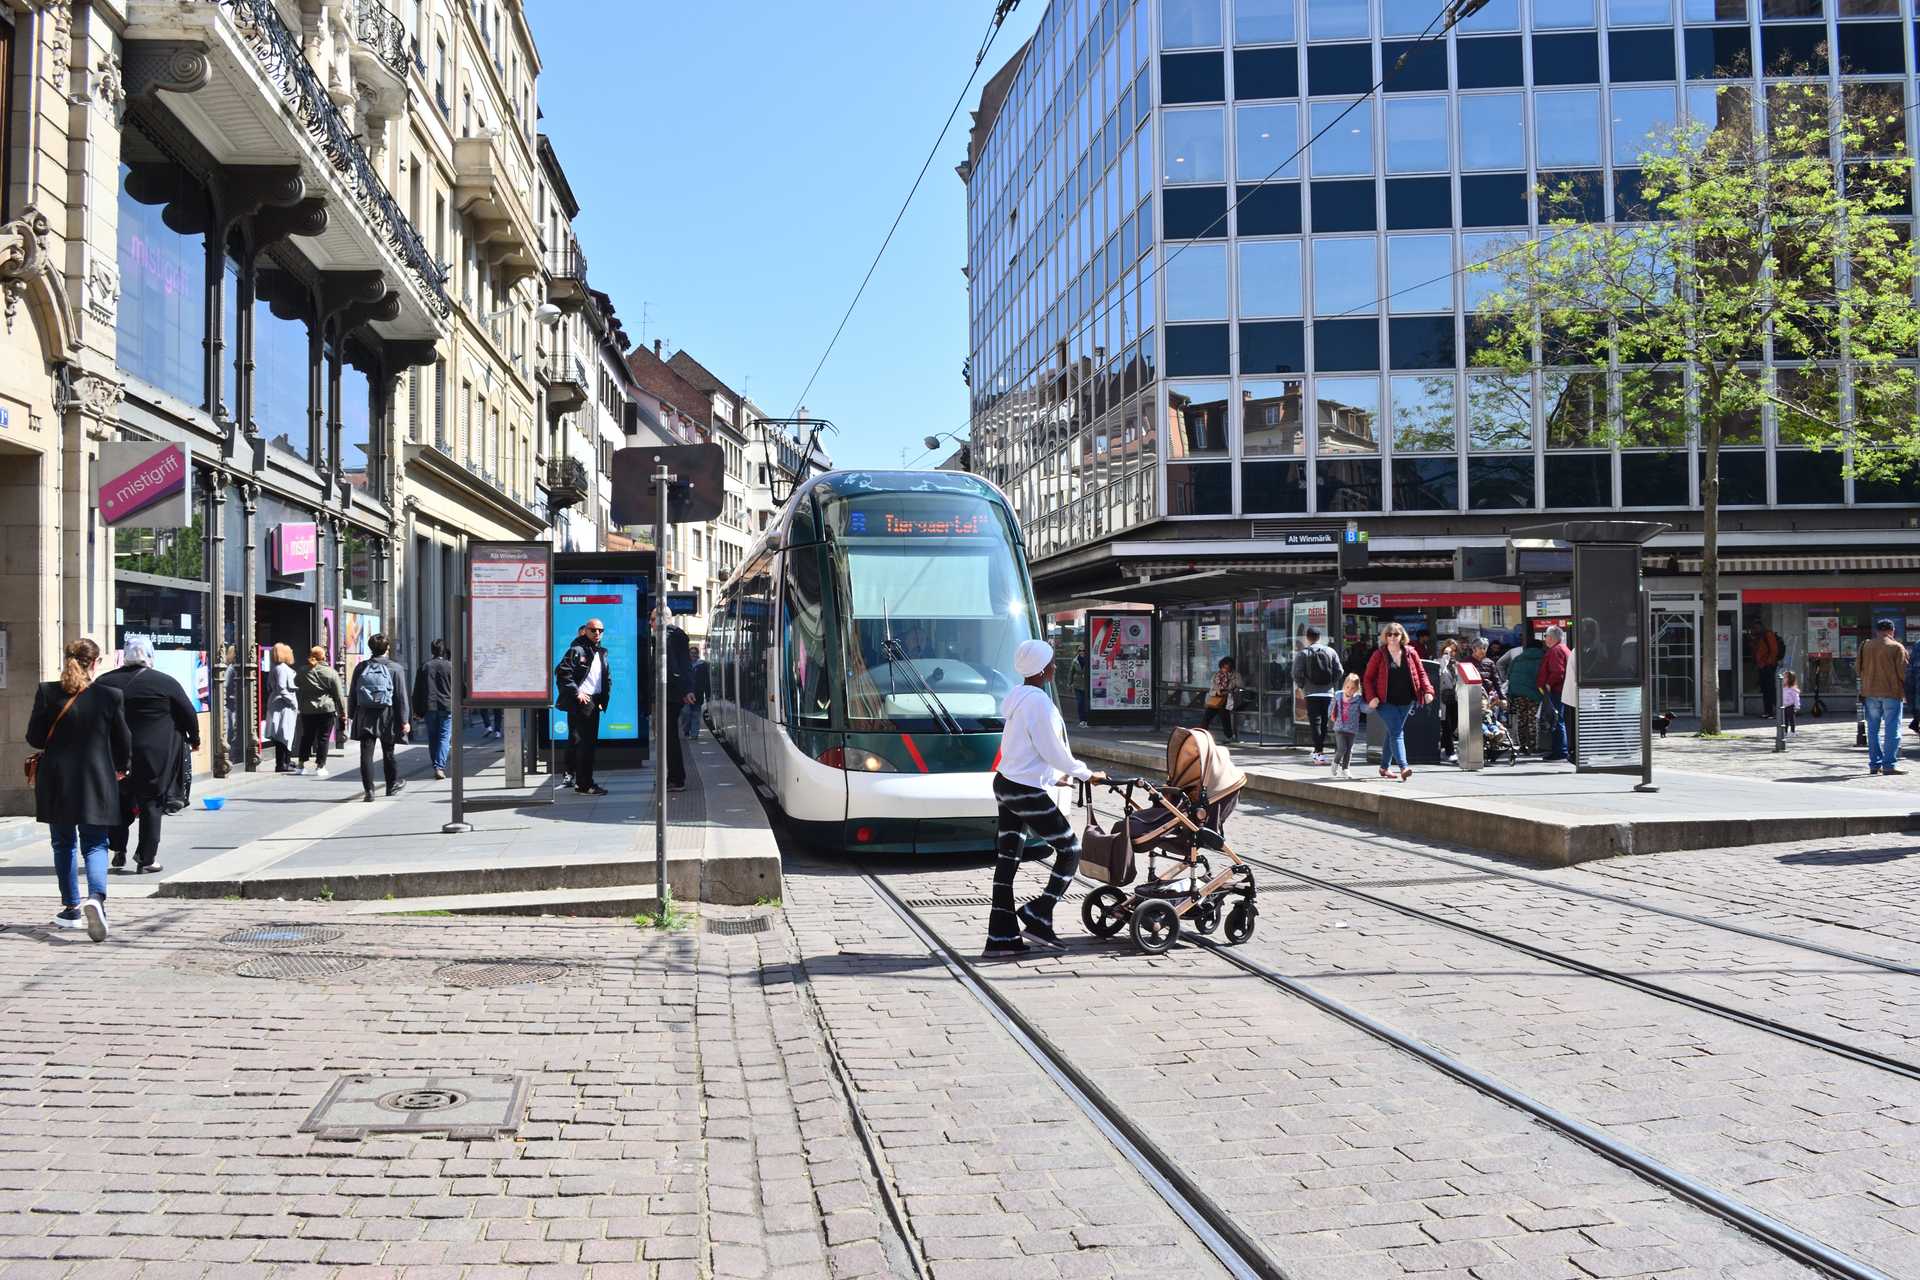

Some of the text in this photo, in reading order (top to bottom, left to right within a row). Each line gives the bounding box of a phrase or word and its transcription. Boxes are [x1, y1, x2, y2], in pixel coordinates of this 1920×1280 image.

[115, 454, 179, 503] mistigriff
[1288, 535, 1298, 543] Alt
[1348, 531, 1356, 542] B
[1359, 531, 1366, 542] F
[524, 566, 545, 577] CTS
[1359, 594, 1379, 606] CTS
